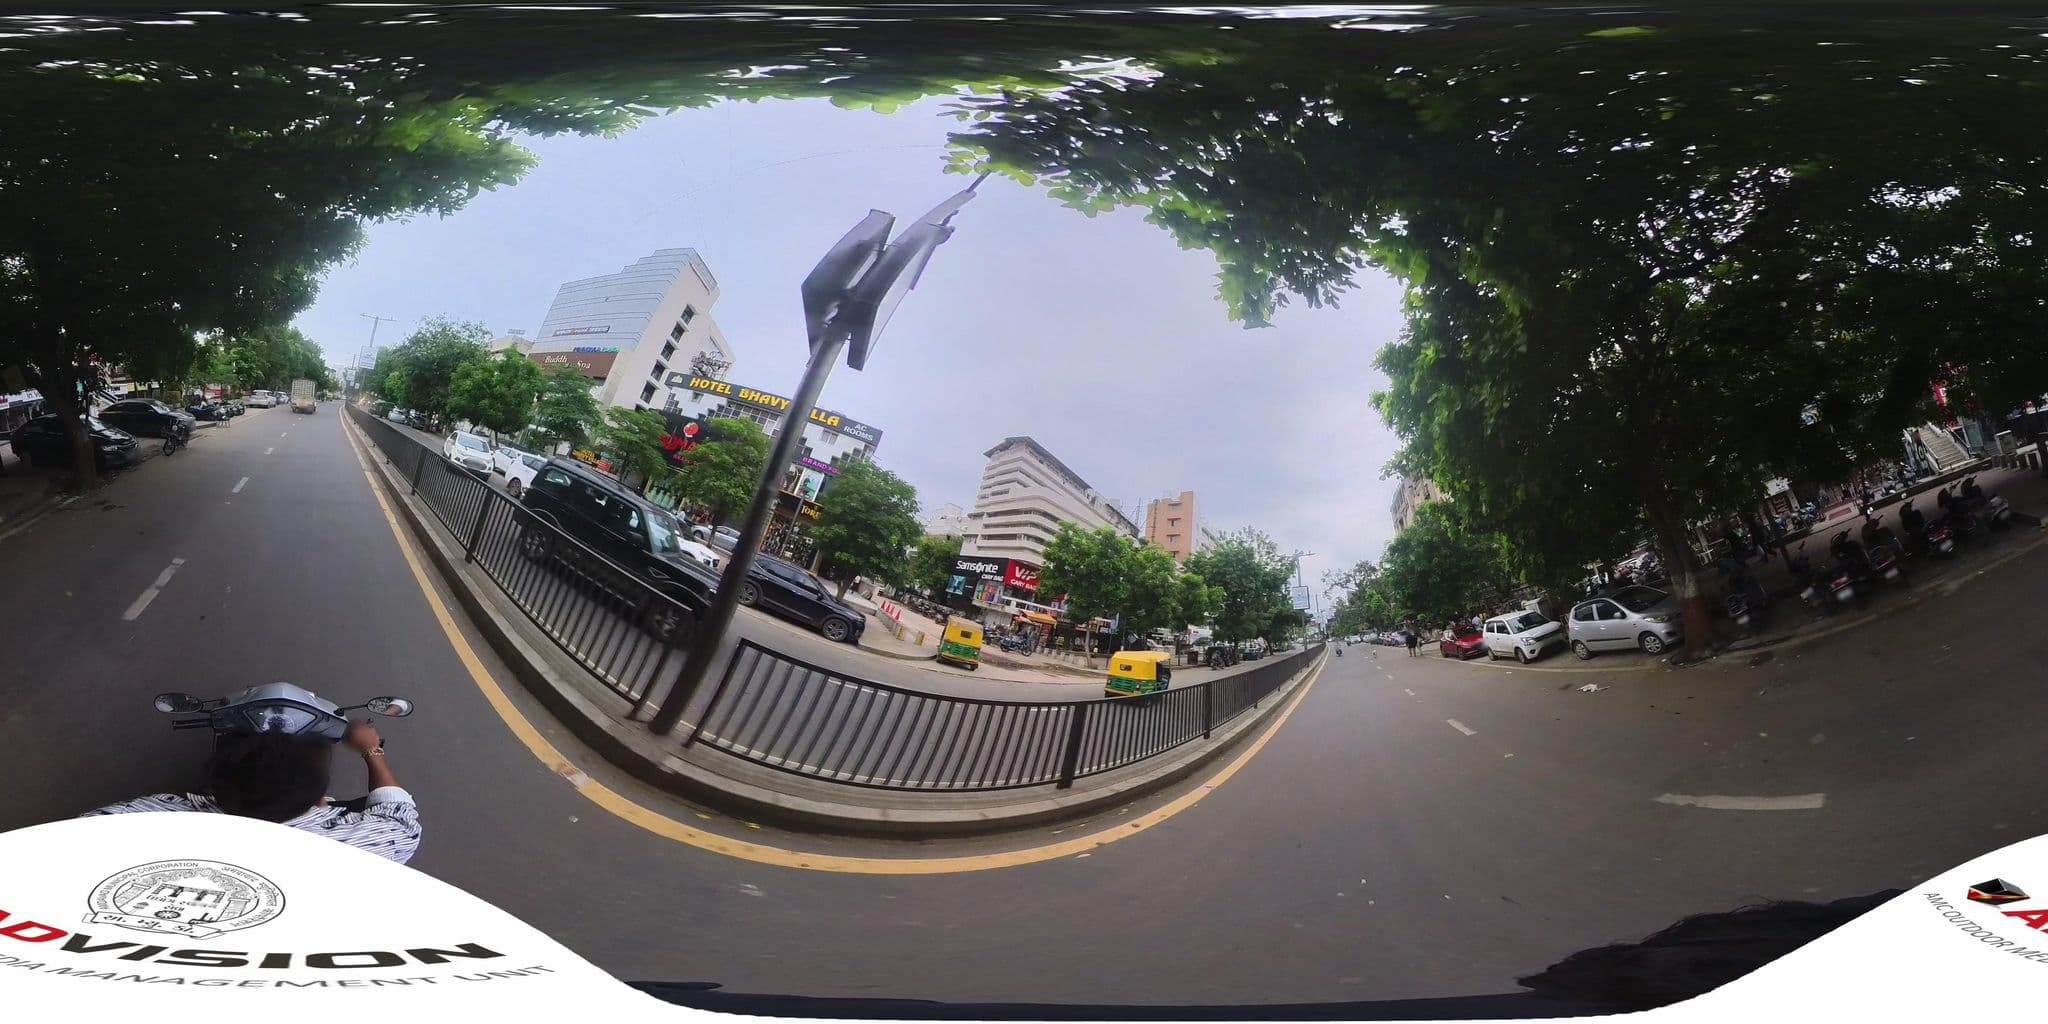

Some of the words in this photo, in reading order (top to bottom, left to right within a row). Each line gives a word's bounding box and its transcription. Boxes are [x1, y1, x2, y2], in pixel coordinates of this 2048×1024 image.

[690, 377, 732, 395] HOTEL
[739, 388, 790, 410] BHAVY
[809, 408, 840, 427] LLA
[843, 425, 874, 441] ROOMS
[854, 423, 867, 432] AC
[802, 456, 828, 470] BRAND
[956, 560, 999, 573] Samsonite
